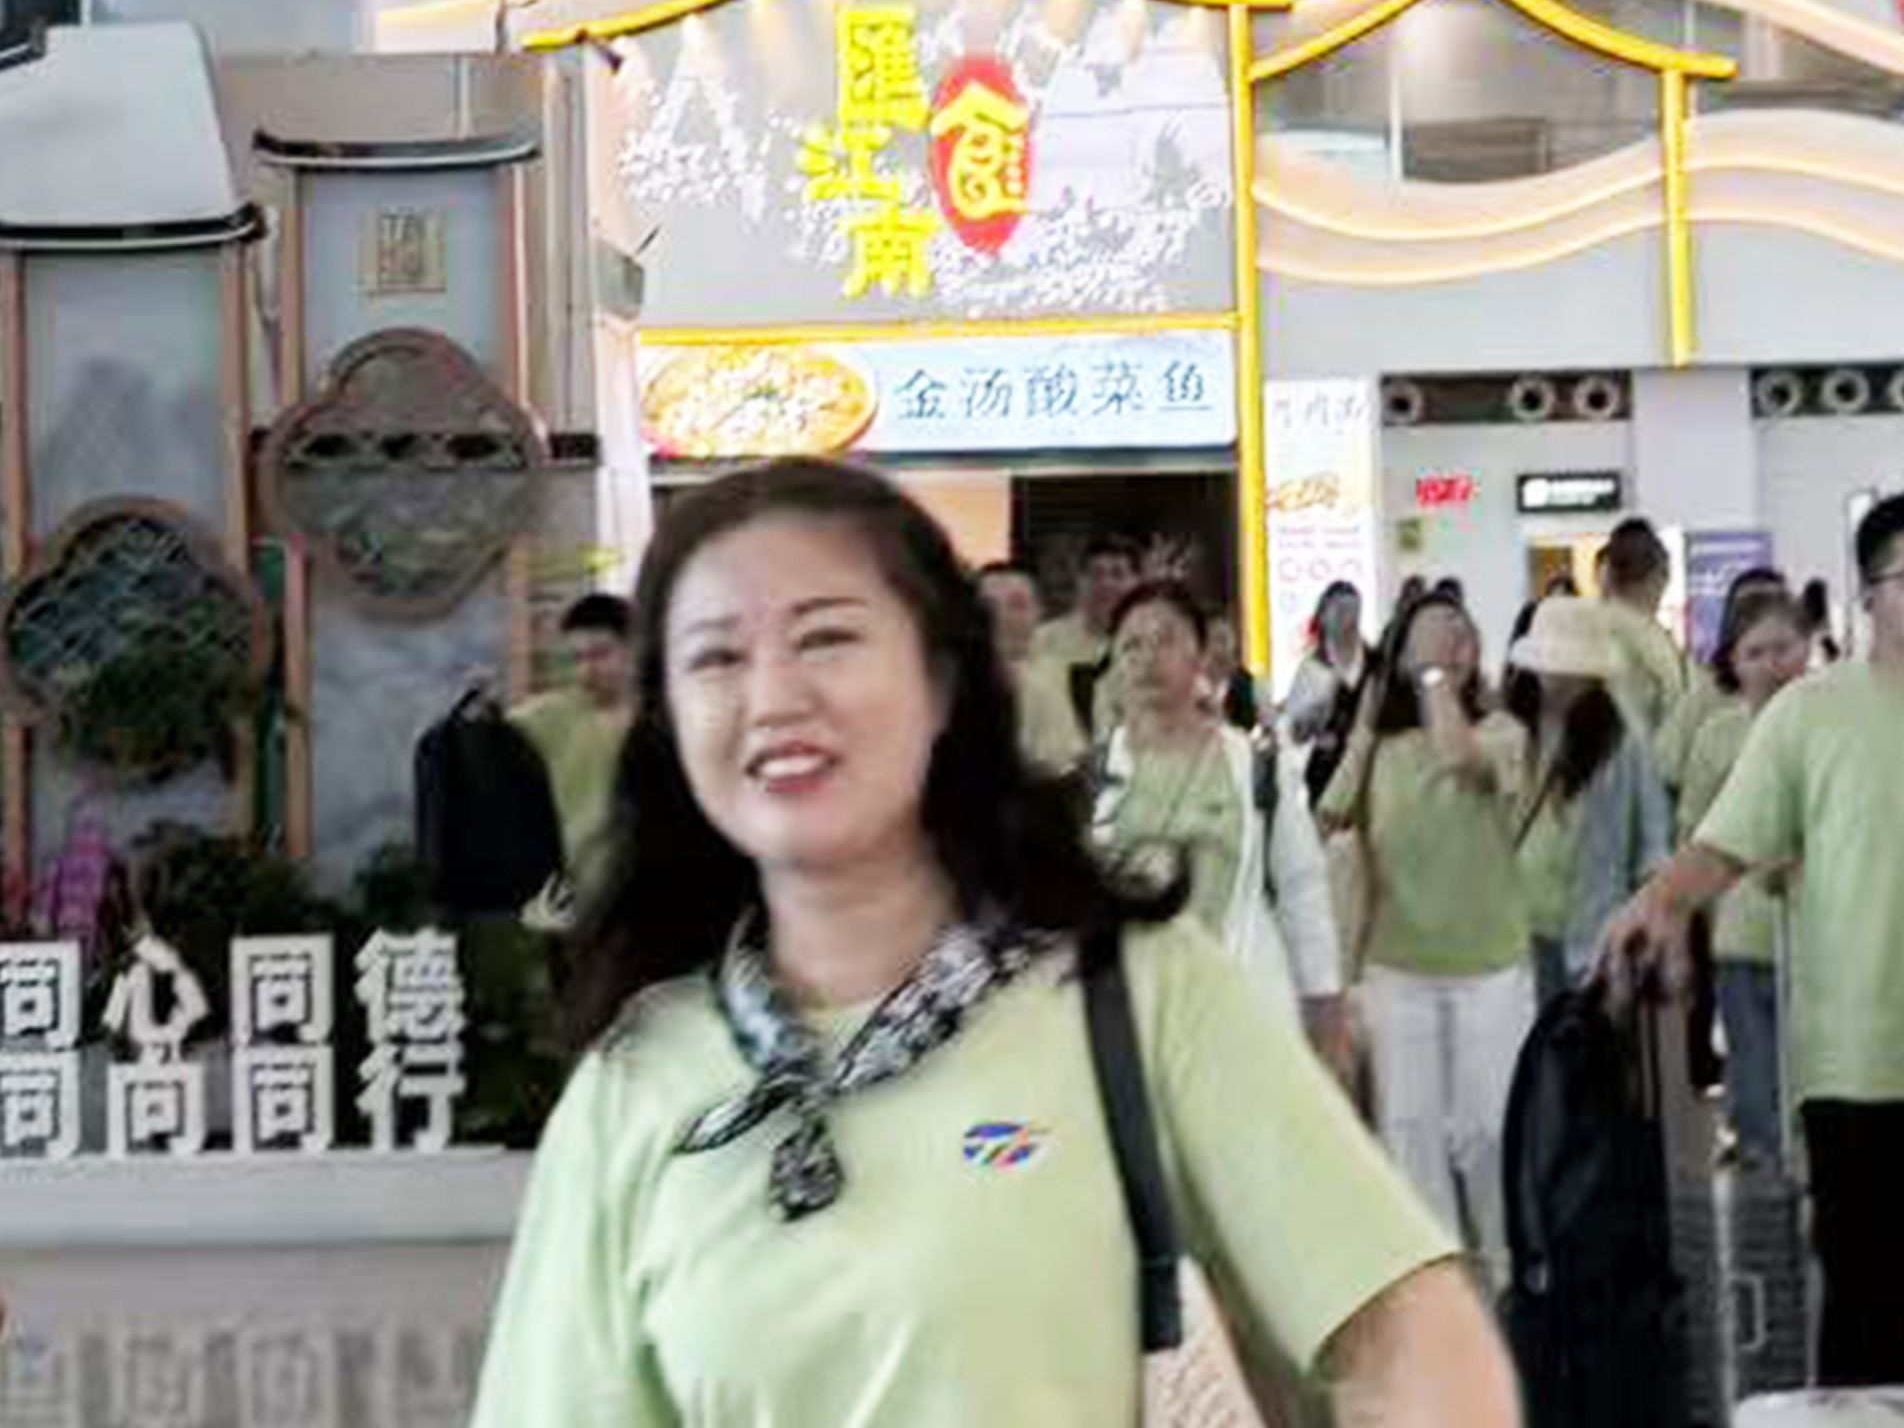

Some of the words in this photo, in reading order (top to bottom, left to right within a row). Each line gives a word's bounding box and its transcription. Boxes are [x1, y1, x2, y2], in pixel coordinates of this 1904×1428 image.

[893, 360, 1214, 420] 金汤酸菜鱼
